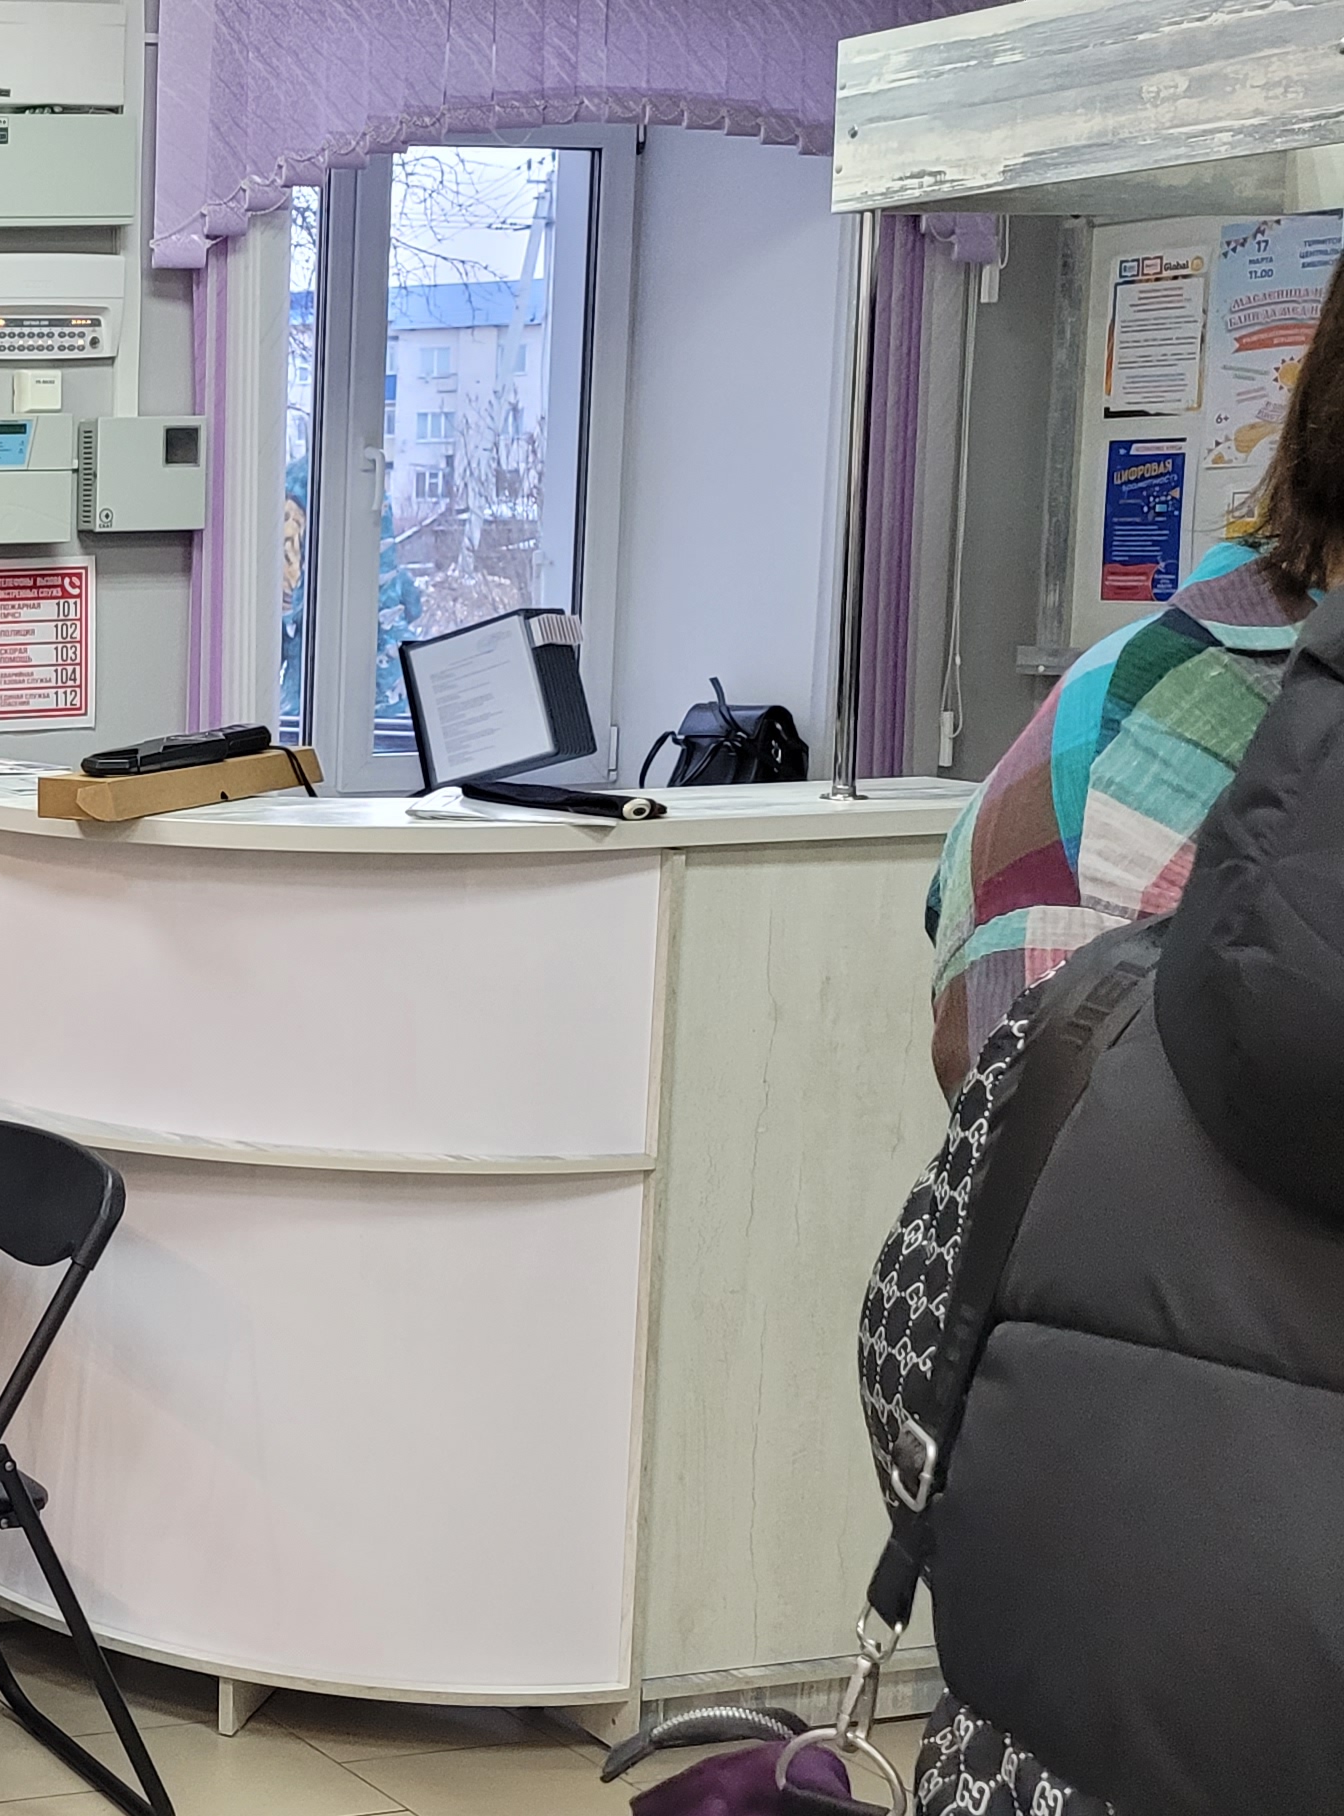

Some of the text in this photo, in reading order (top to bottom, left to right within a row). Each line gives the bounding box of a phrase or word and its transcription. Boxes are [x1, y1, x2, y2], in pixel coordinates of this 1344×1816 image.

[1256, 240, 1269, 253] 17
[1164, 260, 1189, 272] Global
[1248, 269, 1274, 280] 11.00
[1216, 413, 1230, 425] 6+
[1113, 458, 1173, 485] ЦИФРОВАЯ
[0, 600, 78, 618] ПОЖАРНАЯ 101
[0, 622, 78, 640] ПОЛИЦИЯ 102
[0, 645, 78, 663] СКОРАЯ 103
[0, 655, 33, 664] ПОМОЩЬ
[27, 677, 53, 685] СЛУЖБА
[54, 667, 78, 685] 104
[25, 692, 51, 700] СЛУЖБА
[54, 689, 78, 708] 112
